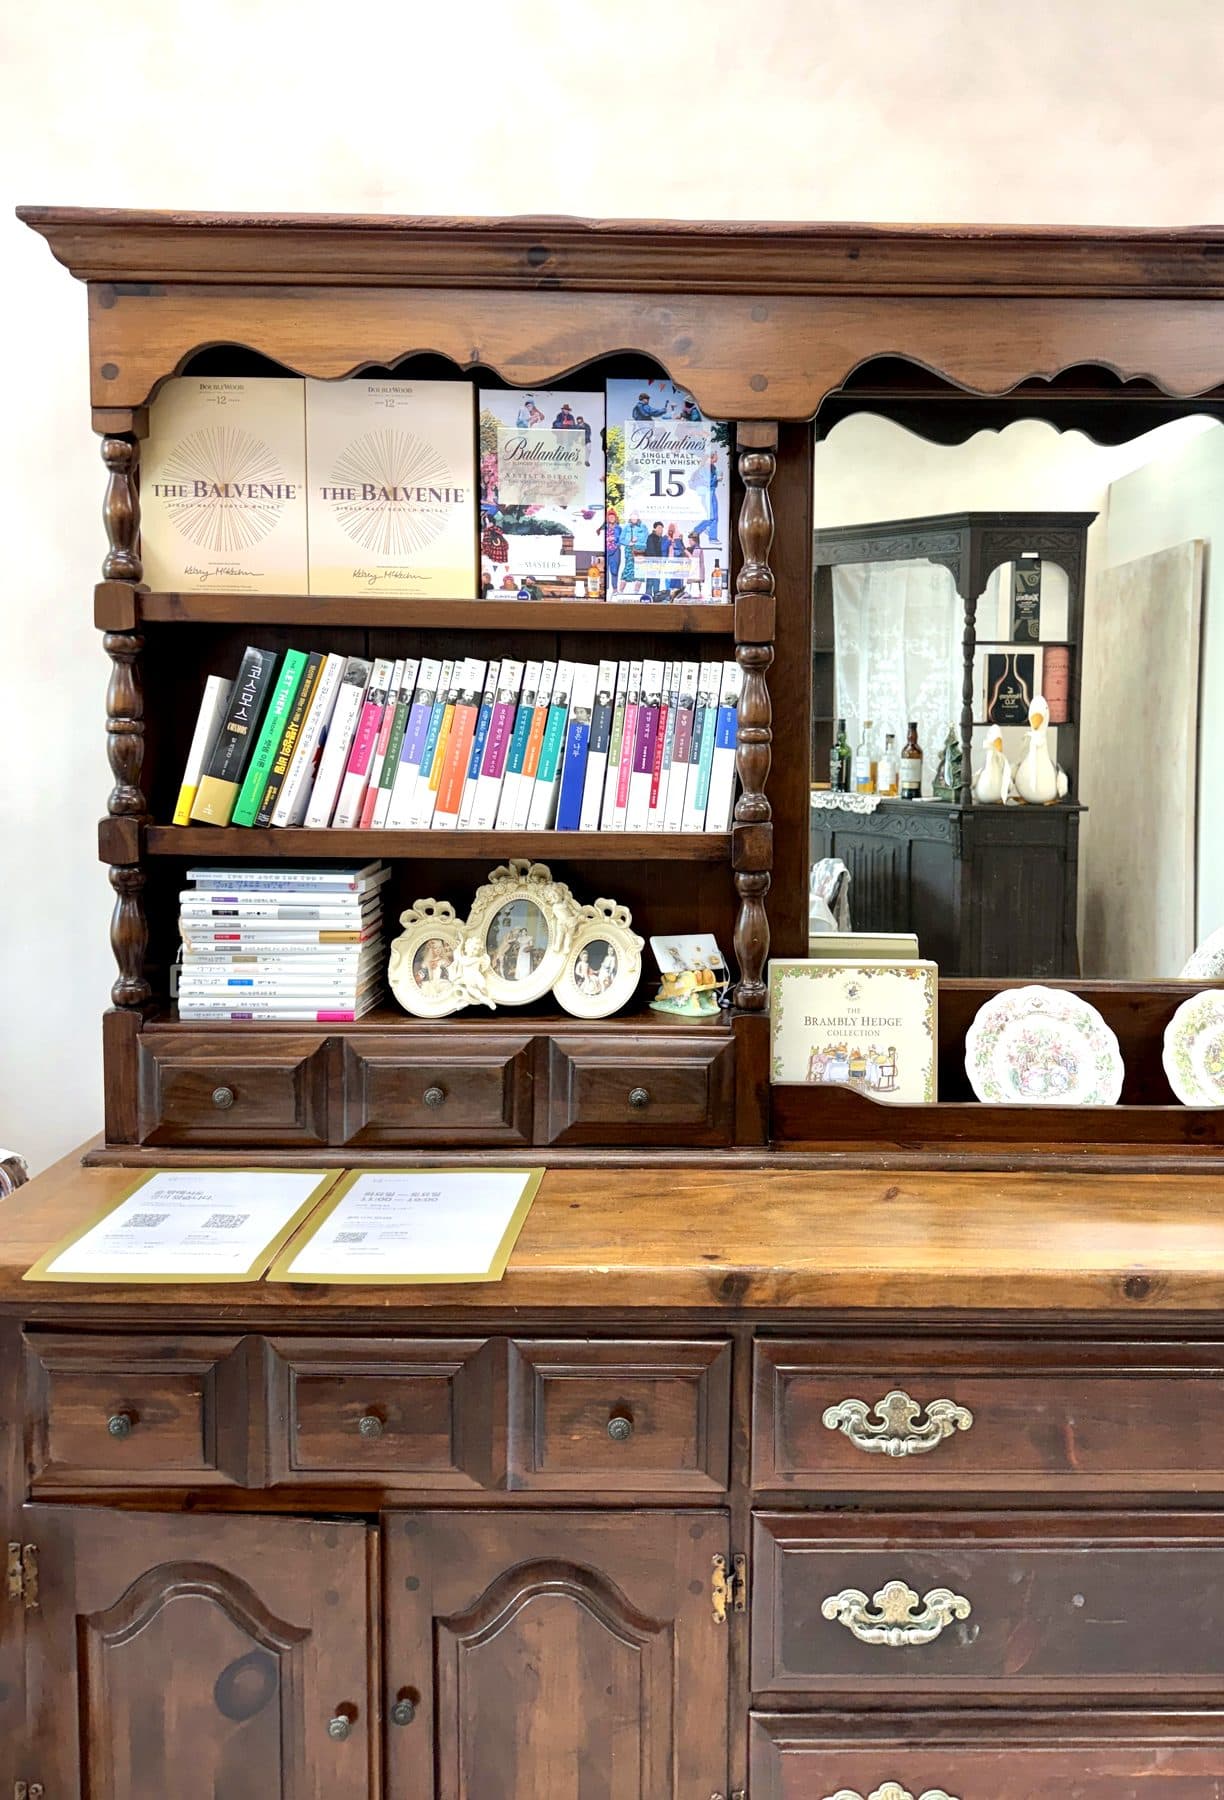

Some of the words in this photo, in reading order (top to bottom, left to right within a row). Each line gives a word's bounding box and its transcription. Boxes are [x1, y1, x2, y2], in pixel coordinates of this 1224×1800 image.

[216, 395, 228, 405] 12
[384, 398, 396, 408] 12
[629, 427, 707, 451] Ballantine's
[504, 436, 581, 462] Ballantine's
[673, 452, 695, 460] MALT
[152, 484, 188, 498] THE
[193, 480, 297, 500] BALVENIE
[649, 468, 687, 498] 15
[320, 487, 356, 501] THE
[361, 483, 465, 503] BALVENIE
[284, 669, 295, 688] LET
[234, 665, 262, 721] 코스모스
[274, 688, 290, 714] THEM
[846, 1007, 862, 1015] THE
[804, 1016, 859, 1027] BRAMBLY
[860, 1016, 903, 1027] HEDGE
[826, 1030, 881, 1038] COLLECTION
